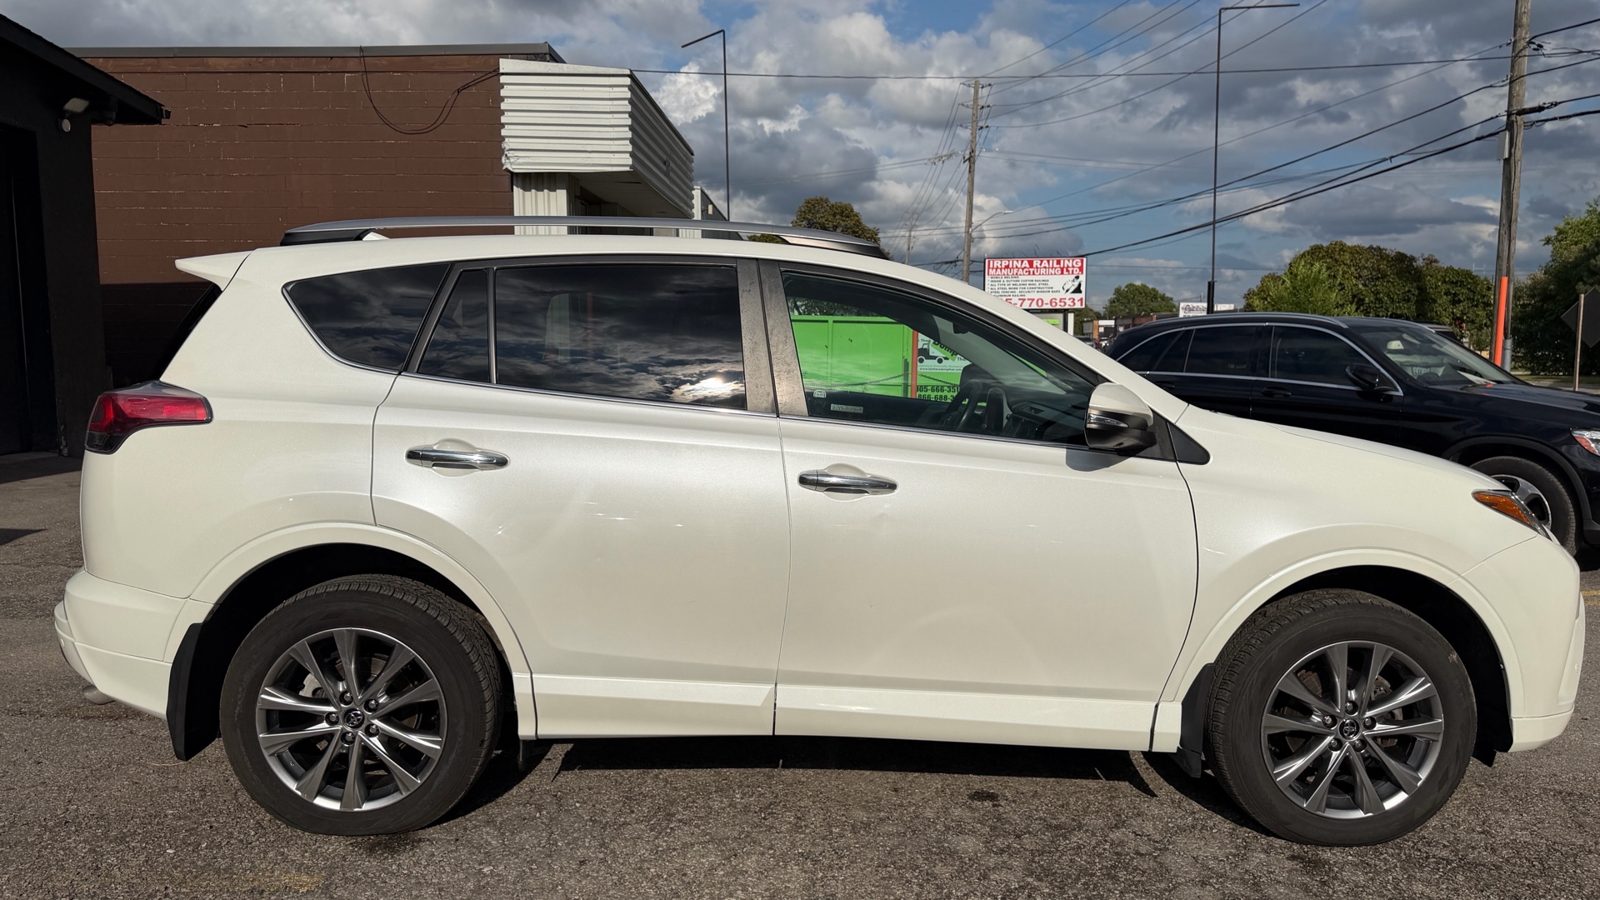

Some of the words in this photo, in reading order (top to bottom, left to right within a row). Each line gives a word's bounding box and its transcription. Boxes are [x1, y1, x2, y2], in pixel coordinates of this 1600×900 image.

[989, 260, 1029, 268] IRPINA
[1033, 259, 1081, 268] RAILING
[1063, 267, 1082, 275] LTD.
[1003, 298, 1084, 308] 5-770-6531
